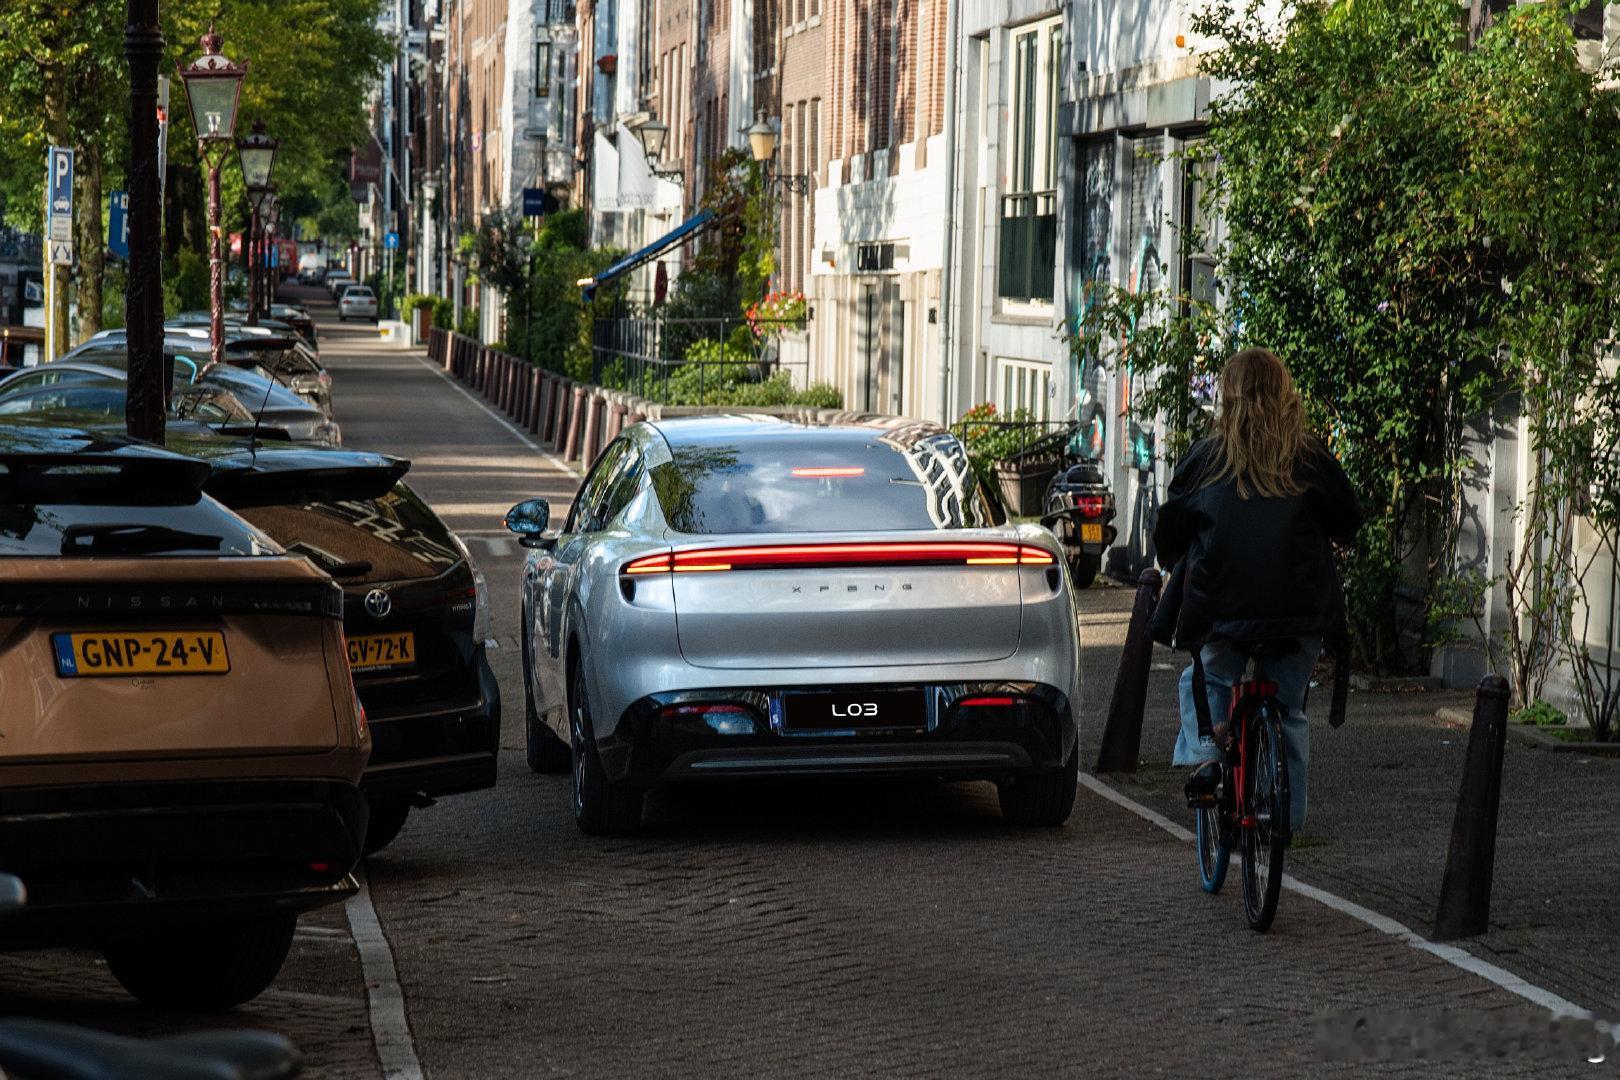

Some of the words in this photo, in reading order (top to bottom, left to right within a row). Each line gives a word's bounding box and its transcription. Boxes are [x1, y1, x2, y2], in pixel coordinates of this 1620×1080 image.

[57, 154, 69, 188] P
[78, 595, 224, 608] NISSAN
[61, 658, 74, 668] NL
[81, 637, 213, 667] GNP-24-V
[348, 636, 410, 663] GV-72-K
